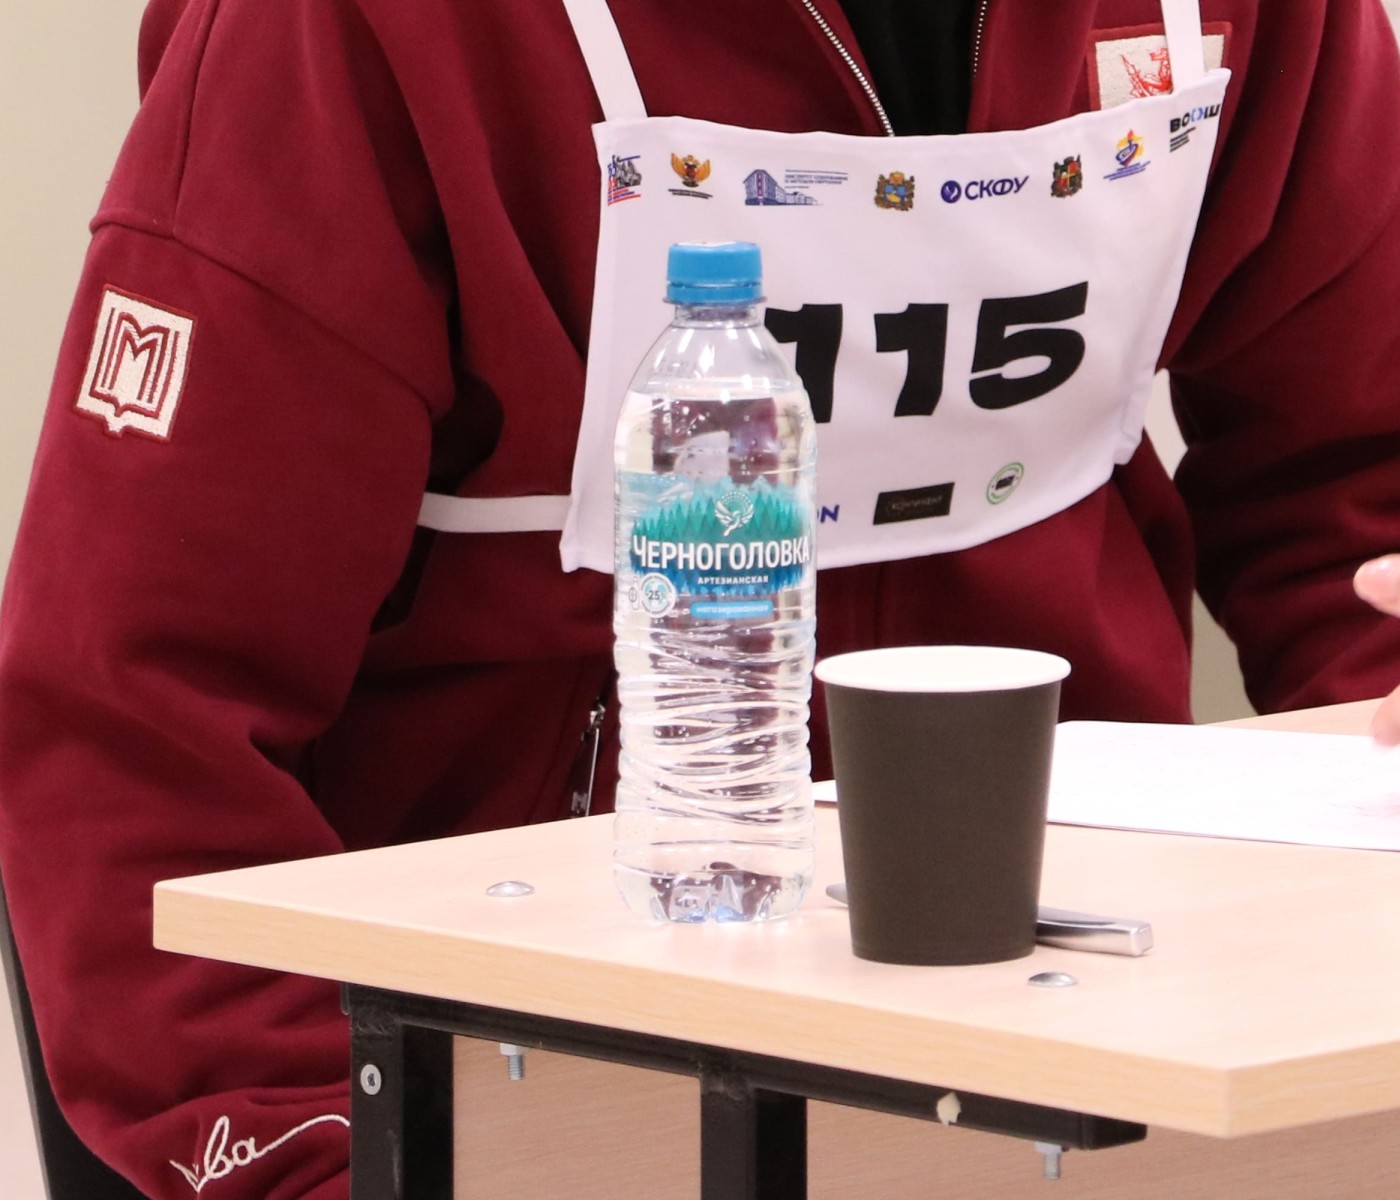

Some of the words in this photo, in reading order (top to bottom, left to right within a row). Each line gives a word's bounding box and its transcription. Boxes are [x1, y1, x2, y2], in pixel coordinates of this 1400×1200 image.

[964, 175, 1030, 200] СКФУ
[764, 280, 1089, 424] 115
[632, 534, 810, 571] ЧЕРНОГОЛОВКА
[697, 575, 769, 585] АРТЕЗИАНСКАЯ
